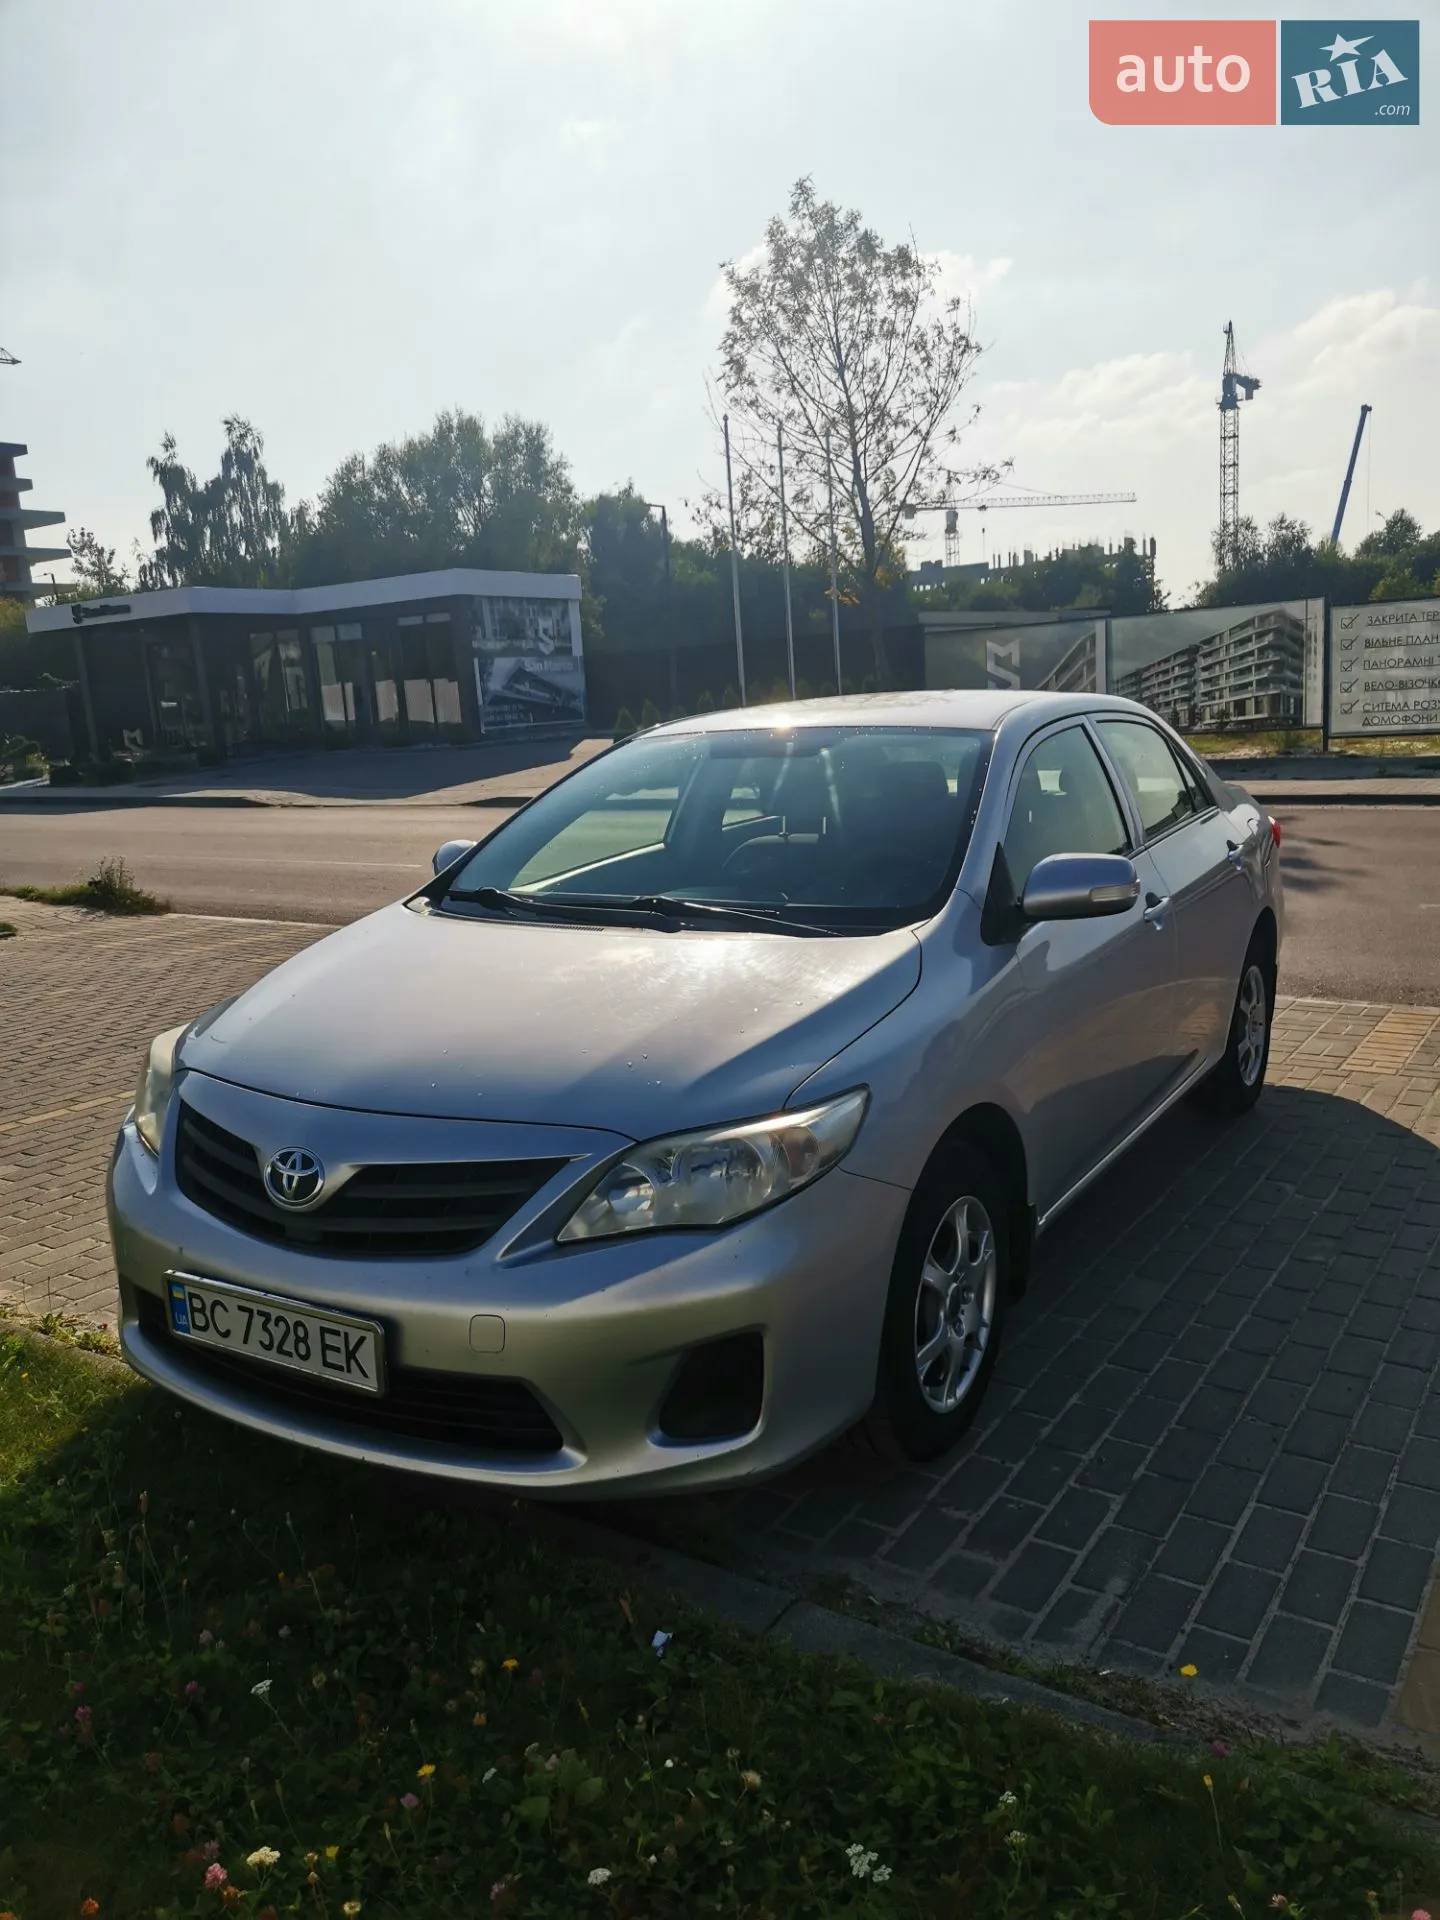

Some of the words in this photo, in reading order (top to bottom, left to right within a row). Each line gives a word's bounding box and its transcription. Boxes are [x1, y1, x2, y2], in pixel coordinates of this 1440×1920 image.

[1367, 612, 1418, 626] ЗАКРИТА
[1364, 635, 1403, 648] ВІЛЬНЕ
[1405, 633, 1439, 646] ПЛАН
[1363, 656, 1434, 669] ПАНОРАМНІ
[1362, 701, 1410, 713] СИТЕМА
[1362, 713, 1437, 726] ДОМОФОНИ
[187, 1291, 232, 1339] BC
[237, 1304, 311, 1361] 7328
[319, 1326, 370, 1379] EK
